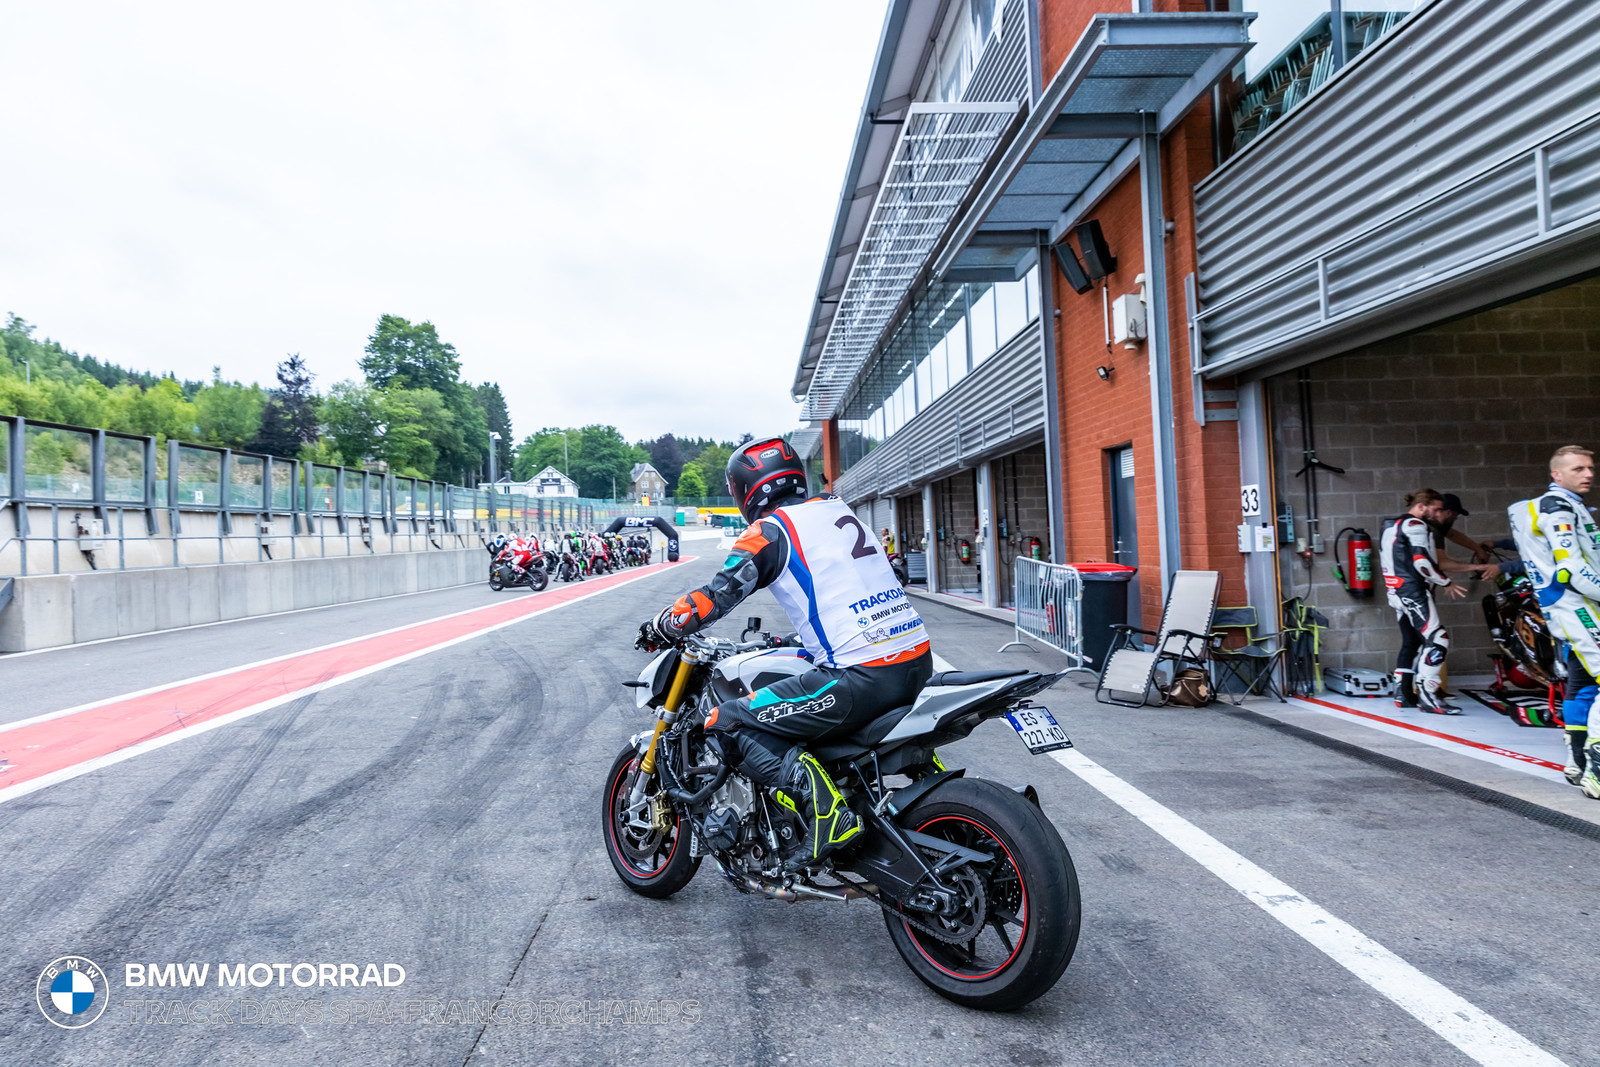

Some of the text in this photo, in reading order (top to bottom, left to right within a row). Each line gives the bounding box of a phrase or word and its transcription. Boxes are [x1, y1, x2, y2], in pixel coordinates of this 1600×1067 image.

[1242, 489, 1259, 513] 33
[834, 515, 878, 560] 2
[848, 587, 905, 614] TRACKDA
[871, 608, 890, 622] BMW
